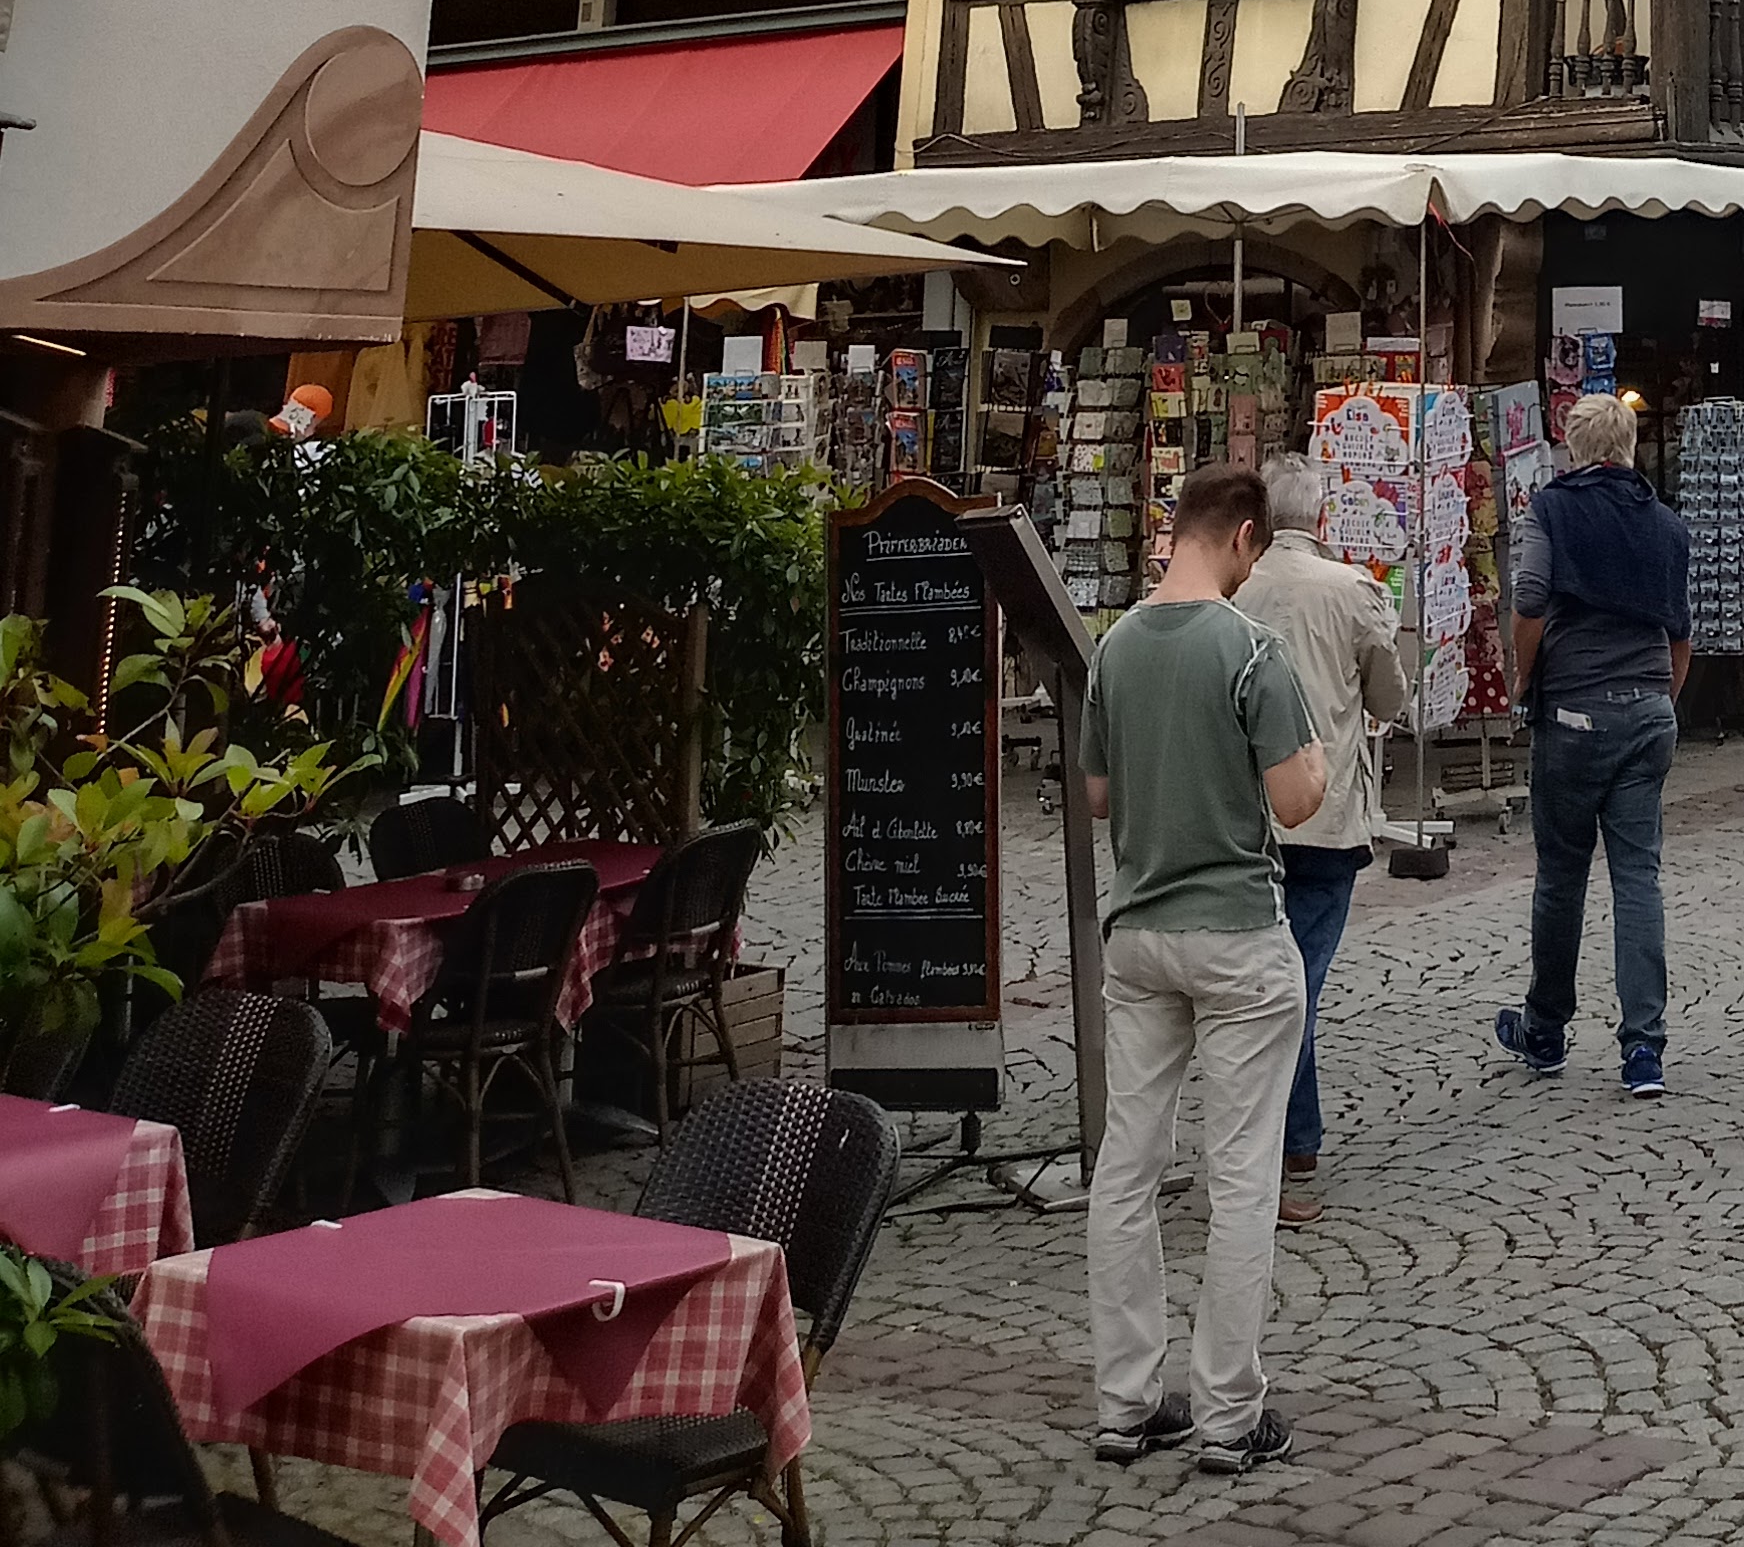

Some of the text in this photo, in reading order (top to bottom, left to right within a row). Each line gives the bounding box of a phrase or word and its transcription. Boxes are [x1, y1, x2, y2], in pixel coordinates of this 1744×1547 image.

[841, 572, 866, 604] Nos
[874, 580, 908, 602] Tartes
[839, 627, 928, 654] Traditionnelle
[842, 666, 926, 701] Champignons
[845, 768, 906, 793] Munster
[894, 852, 921, 874] miel
